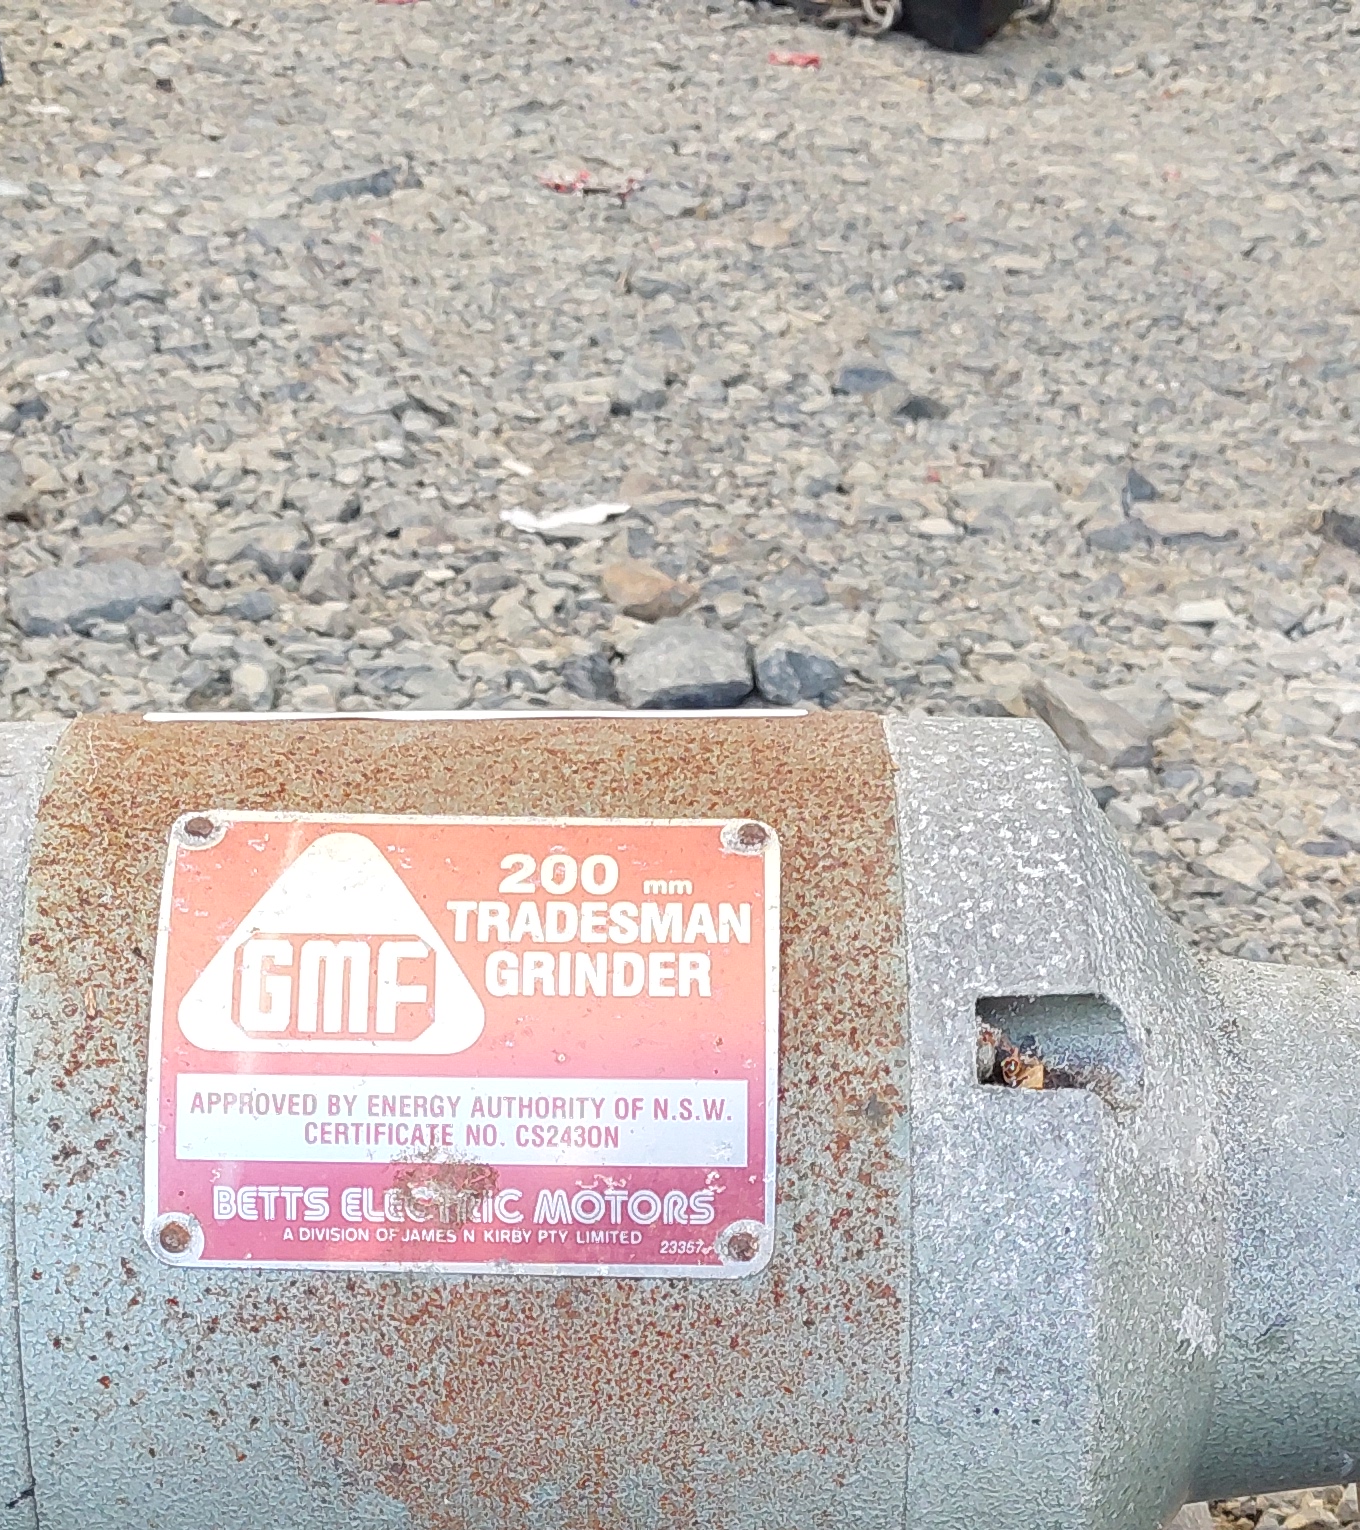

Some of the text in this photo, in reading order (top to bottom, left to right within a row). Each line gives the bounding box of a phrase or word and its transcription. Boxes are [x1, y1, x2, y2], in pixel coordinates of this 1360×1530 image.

[498, 853, 693, 896] 200 mm
[446, 900, 751, 945] TRADESMAN
[238, 938, 430, 1034] GMF
[484, 950, 713, 998] GRINDER
[189, 1090, 732, 1123] APPROVED BY ENERGY AUTHORITY OF N.S.W.
[303, 1121, 454, 1147] CERTIFICATE
[464, 1123, 505, 1148] NO.
[214, 1185, 715, 1225] BETTS ELECTRIC MOTORS
[283, 1227, 642, 1246] A DIVISION OF JAMES N KIRBY PTY LIMITED
